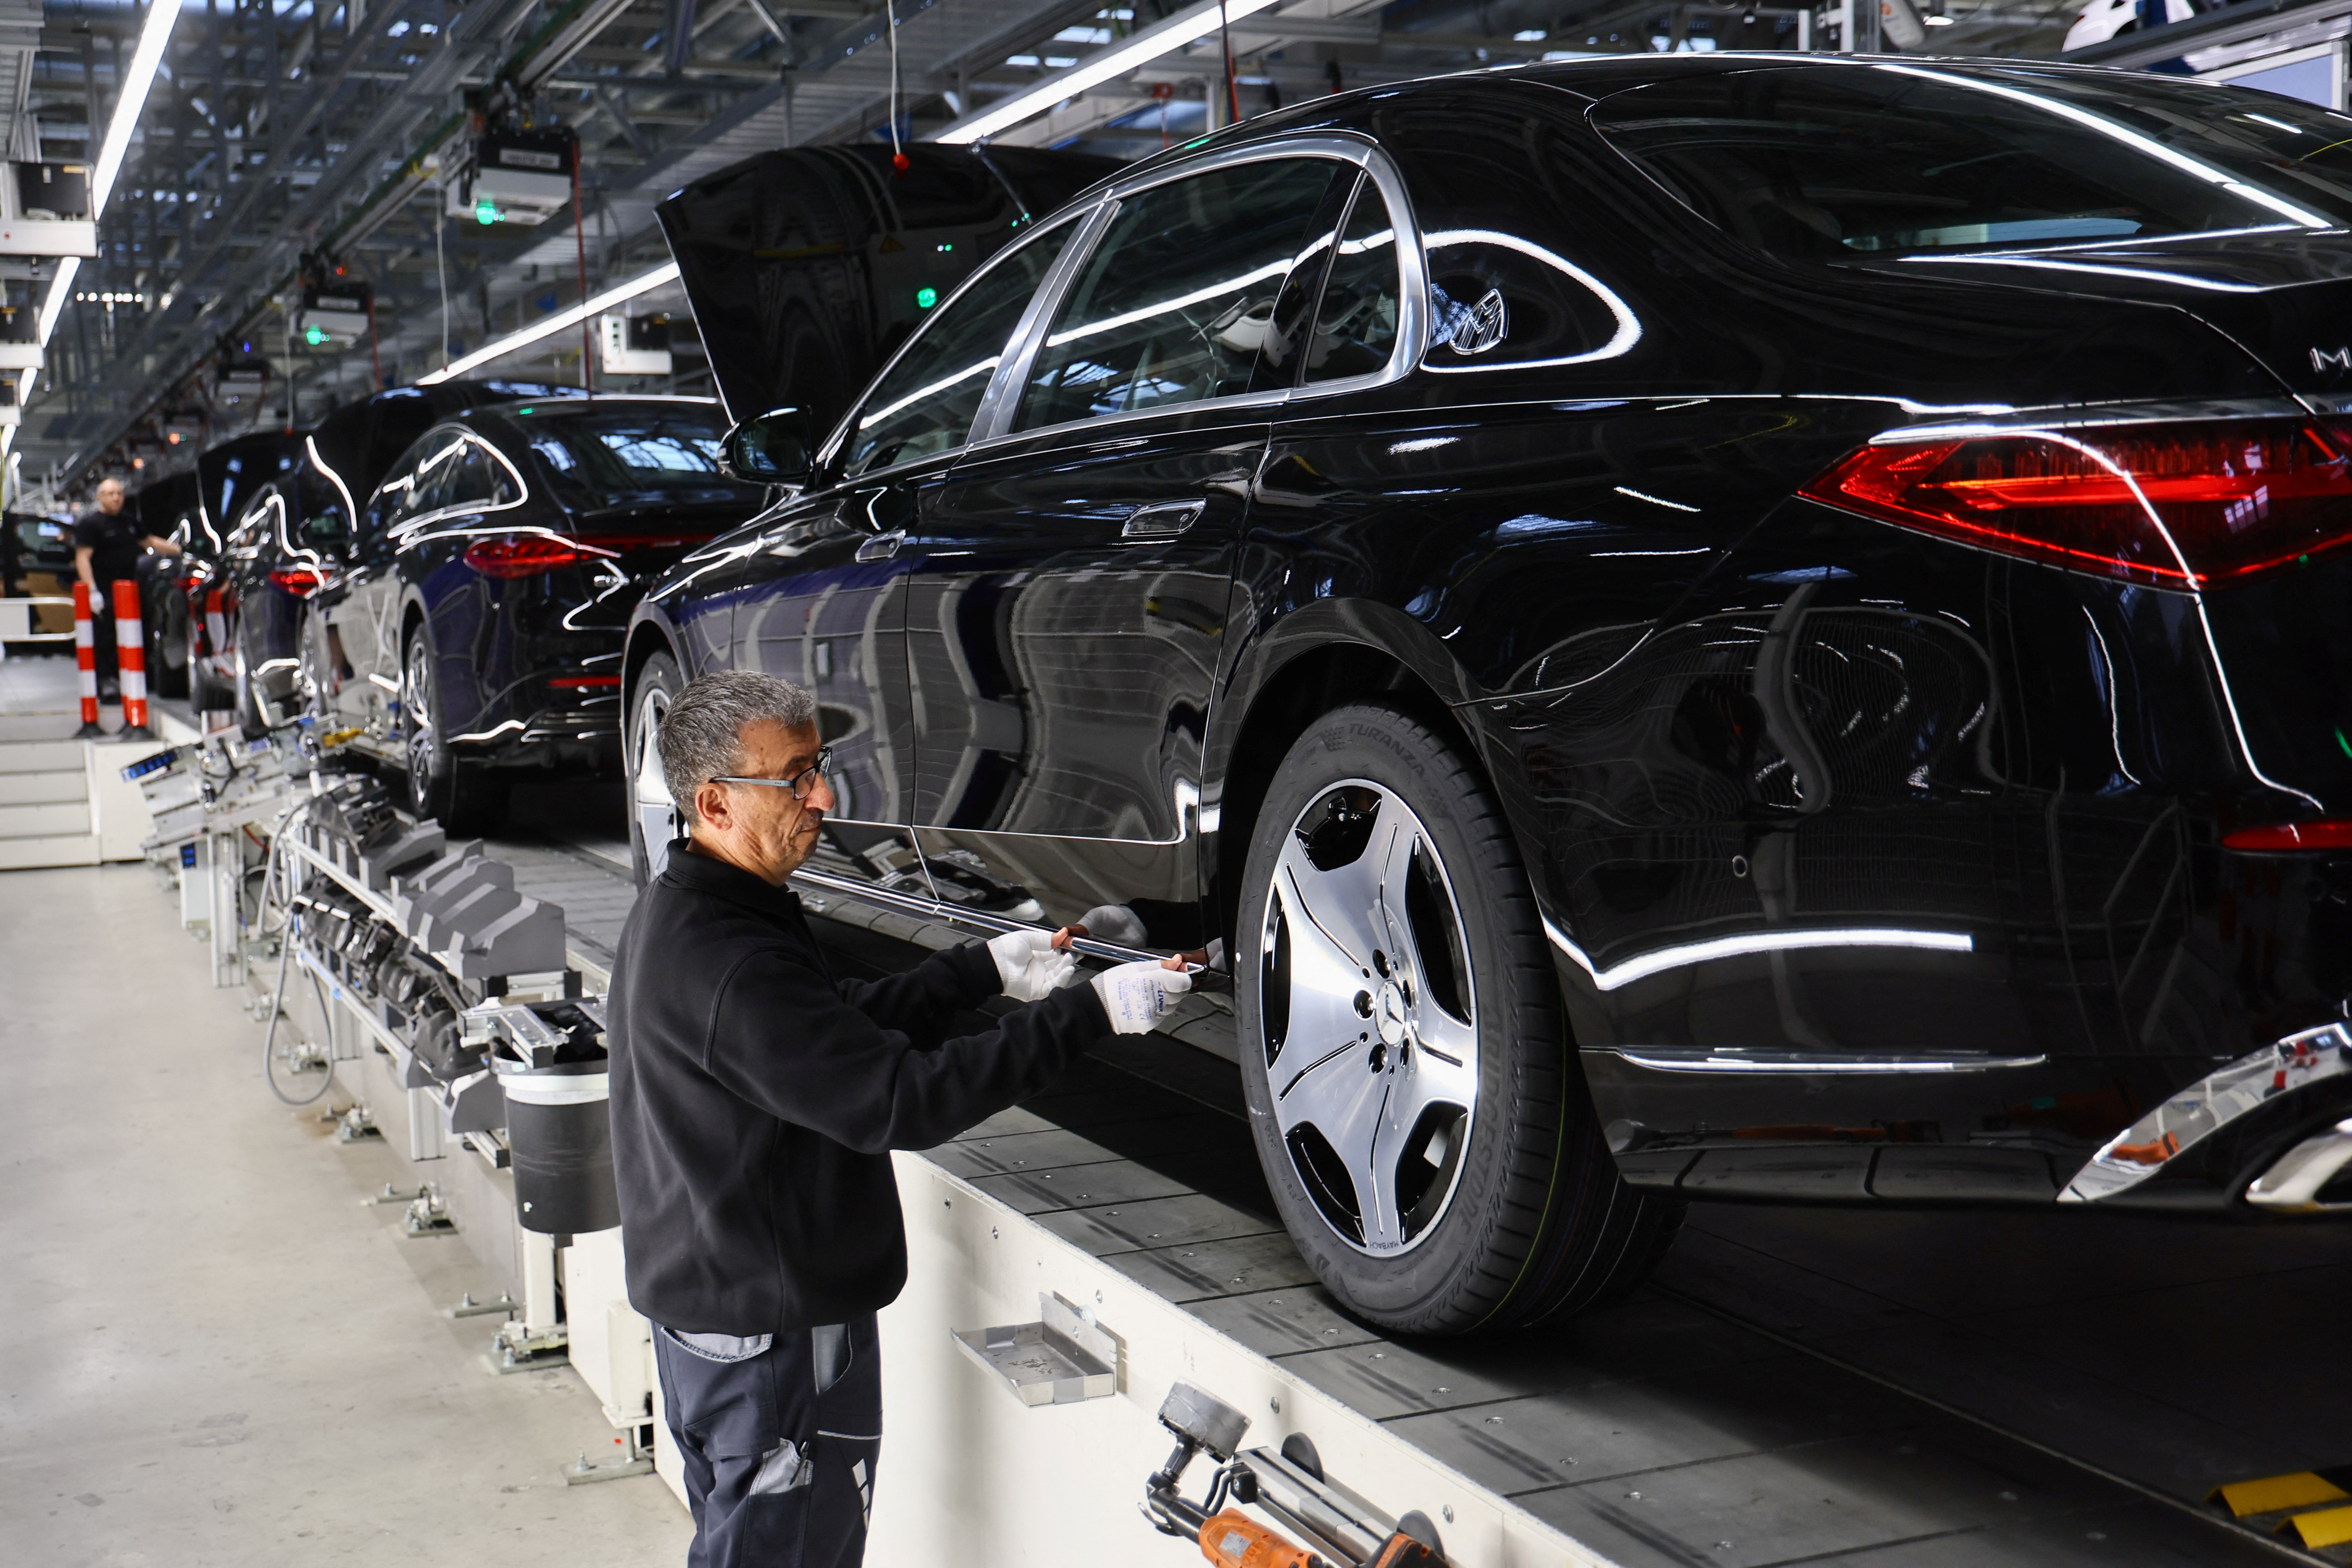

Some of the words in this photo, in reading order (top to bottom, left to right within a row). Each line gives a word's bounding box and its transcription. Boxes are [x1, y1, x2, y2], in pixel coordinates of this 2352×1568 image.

[1349, 723, 1426, 777] TURANZA
[1457, 1001, 1503, 1234] BRIDGESTONE
[1369, 1240, 1399, 1250] MAYBACH
